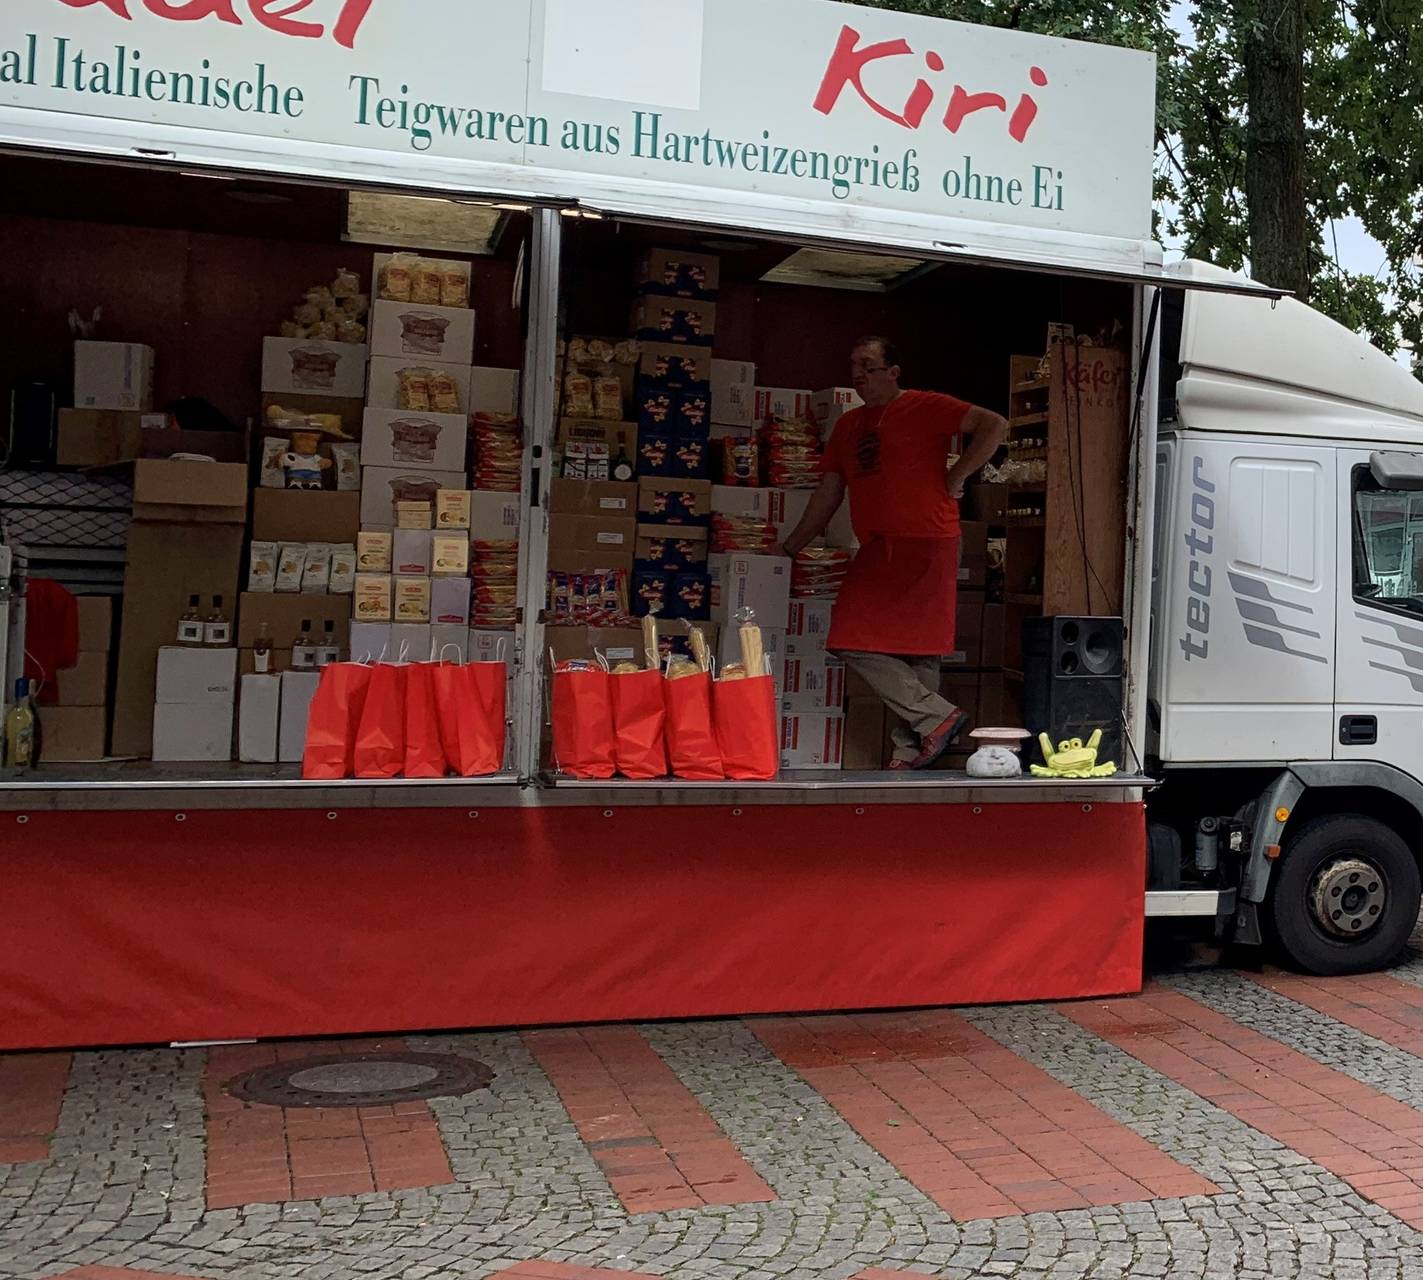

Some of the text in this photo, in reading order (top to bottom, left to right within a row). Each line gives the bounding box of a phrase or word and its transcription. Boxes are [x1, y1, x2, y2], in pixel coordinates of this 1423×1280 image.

[50, 37, 304, 118] Italienische
[348, 75, 550, 150] Teigwaren
[560, 120, 621, 155] aus
[630, 111, 920, 199] Hartweizengrieß
[943, 155, 1023, 206] ohne
[1031, 165, 1065, 211] Ei
[813, 24, 1048, 144] Kiri
[1179, 456, 1216, 662] tector
